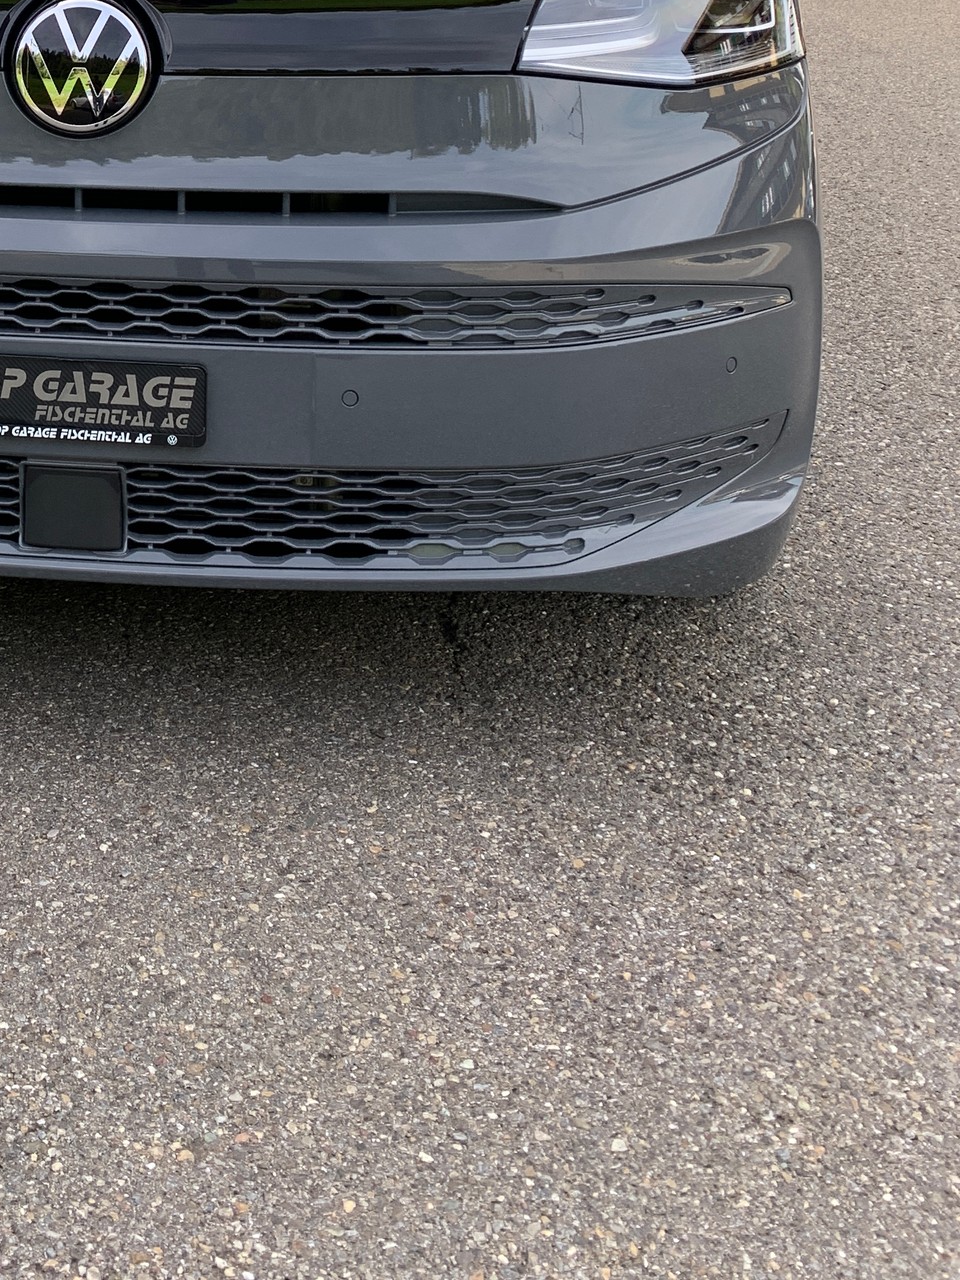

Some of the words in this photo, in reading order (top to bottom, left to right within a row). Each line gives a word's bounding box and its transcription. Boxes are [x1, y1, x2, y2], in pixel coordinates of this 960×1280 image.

[18, 0, 146, 129] VW
[33, 369, 197, 410] GARAGE
[35, 404, 155, 428] FISCHENTHAL
[160, 412, 190, 429] AG
[11, 426, 58, 439] GARAGE
[60, 428, 132, 443] FISCHENTHAL
[134, 433, 153, 444] AG
